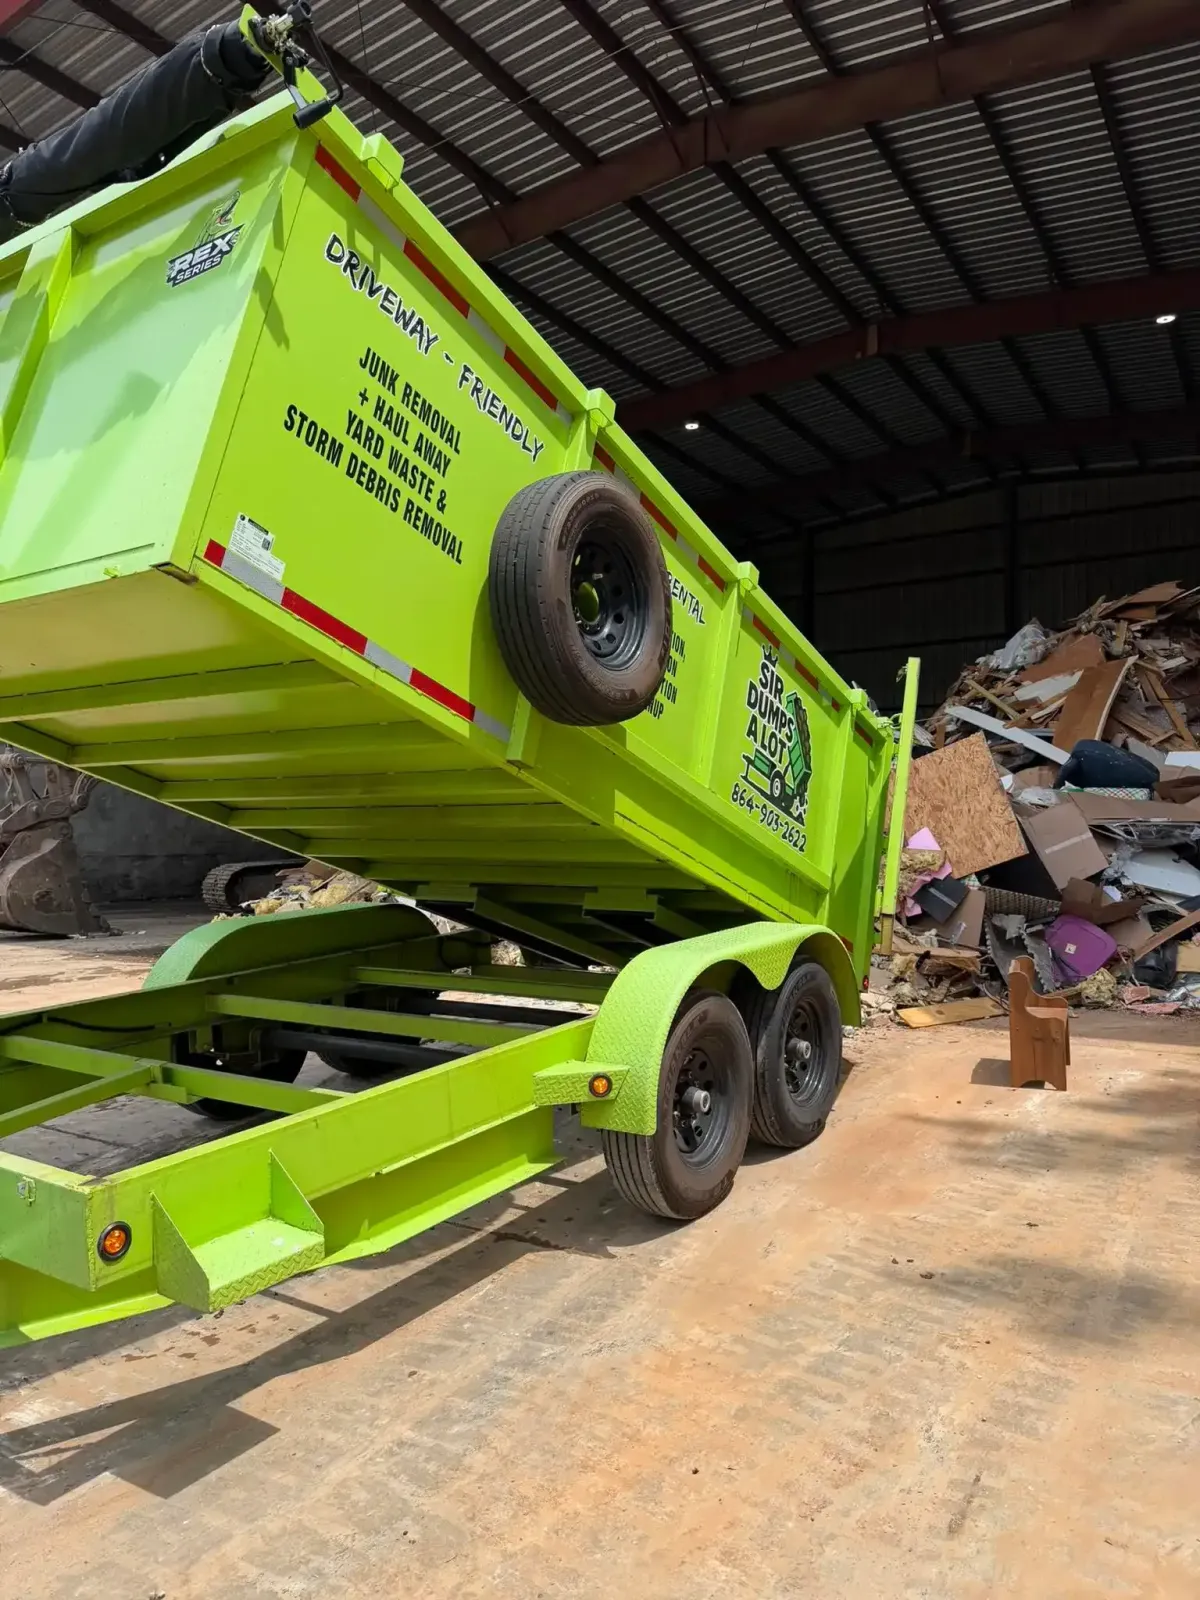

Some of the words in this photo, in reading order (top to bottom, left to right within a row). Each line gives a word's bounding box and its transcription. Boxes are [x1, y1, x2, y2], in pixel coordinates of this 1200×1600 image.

[170, 230, 236, 278] REX
[174, 253, 222, 284] SERIES
[325, 232, 440, 356] DRIVEWAY
[458, 363, 545, 463] FRIENDLY
[359, 346, 400, 397] JUNK
[401, 381, 461, 455] REMOVAL
[345, 408, 385, 460] YARD
[388, 445, 435, 504] WASTE
[436, 488, 447, 516] &
[373, 395, 410, 446] HAUL
[413, 431, 452, 479] AWAY
[283, 403, 345, 469] STORM
[345, 451, 401, 513] DEBRIS
[402, 497, 463, 565] REMOVAL
[746, 680, 796, 745] DUMPS
[758, 659, 785, 702] SIR
[746, 712, 759, 746] A
[759, 731, 788, 765] LOT
[731, 782, 807, 854] 864-903-2622
